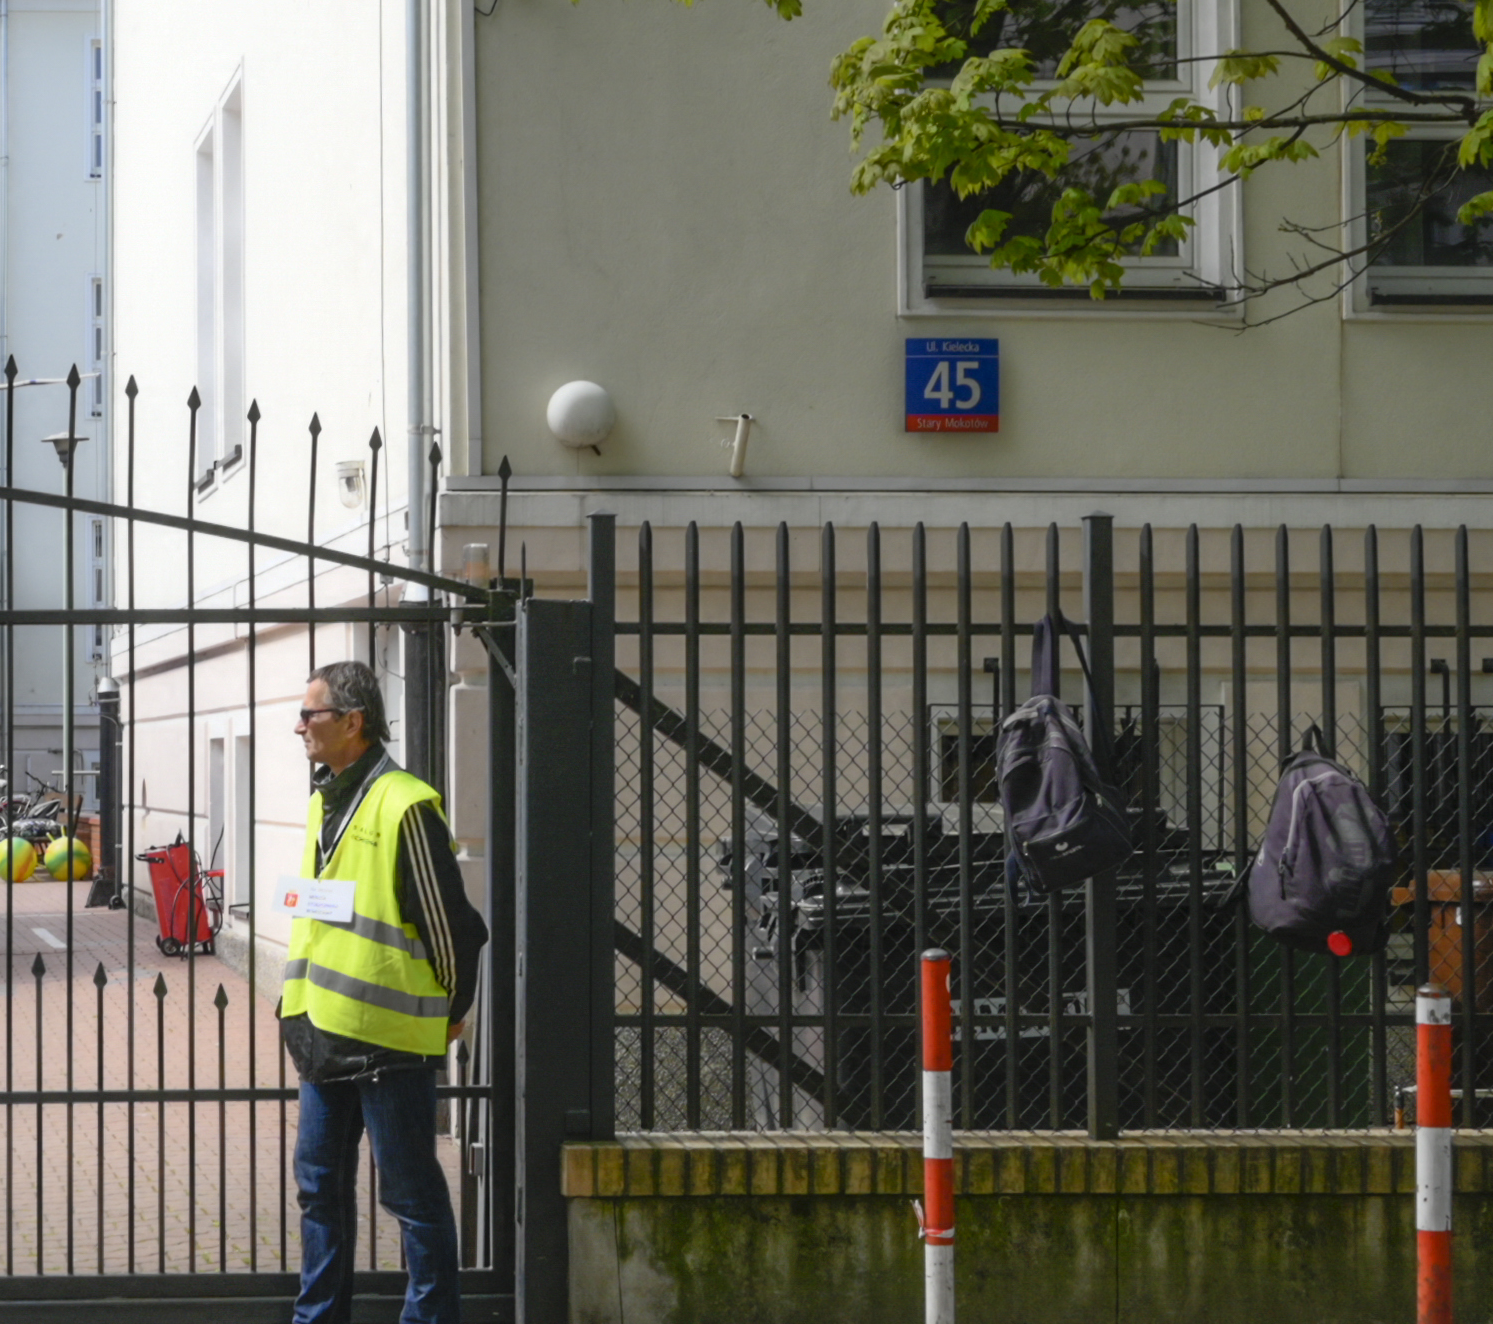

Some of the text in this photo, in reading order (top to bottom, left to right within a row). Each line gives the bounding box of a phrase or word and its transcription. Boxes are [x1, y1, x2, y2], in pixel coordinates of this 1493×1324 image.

[942, 341, 980, 352] Kielecka
[923, 360, 982, 410] 45
[917, 417, 989, 431] Stary Mokotów
